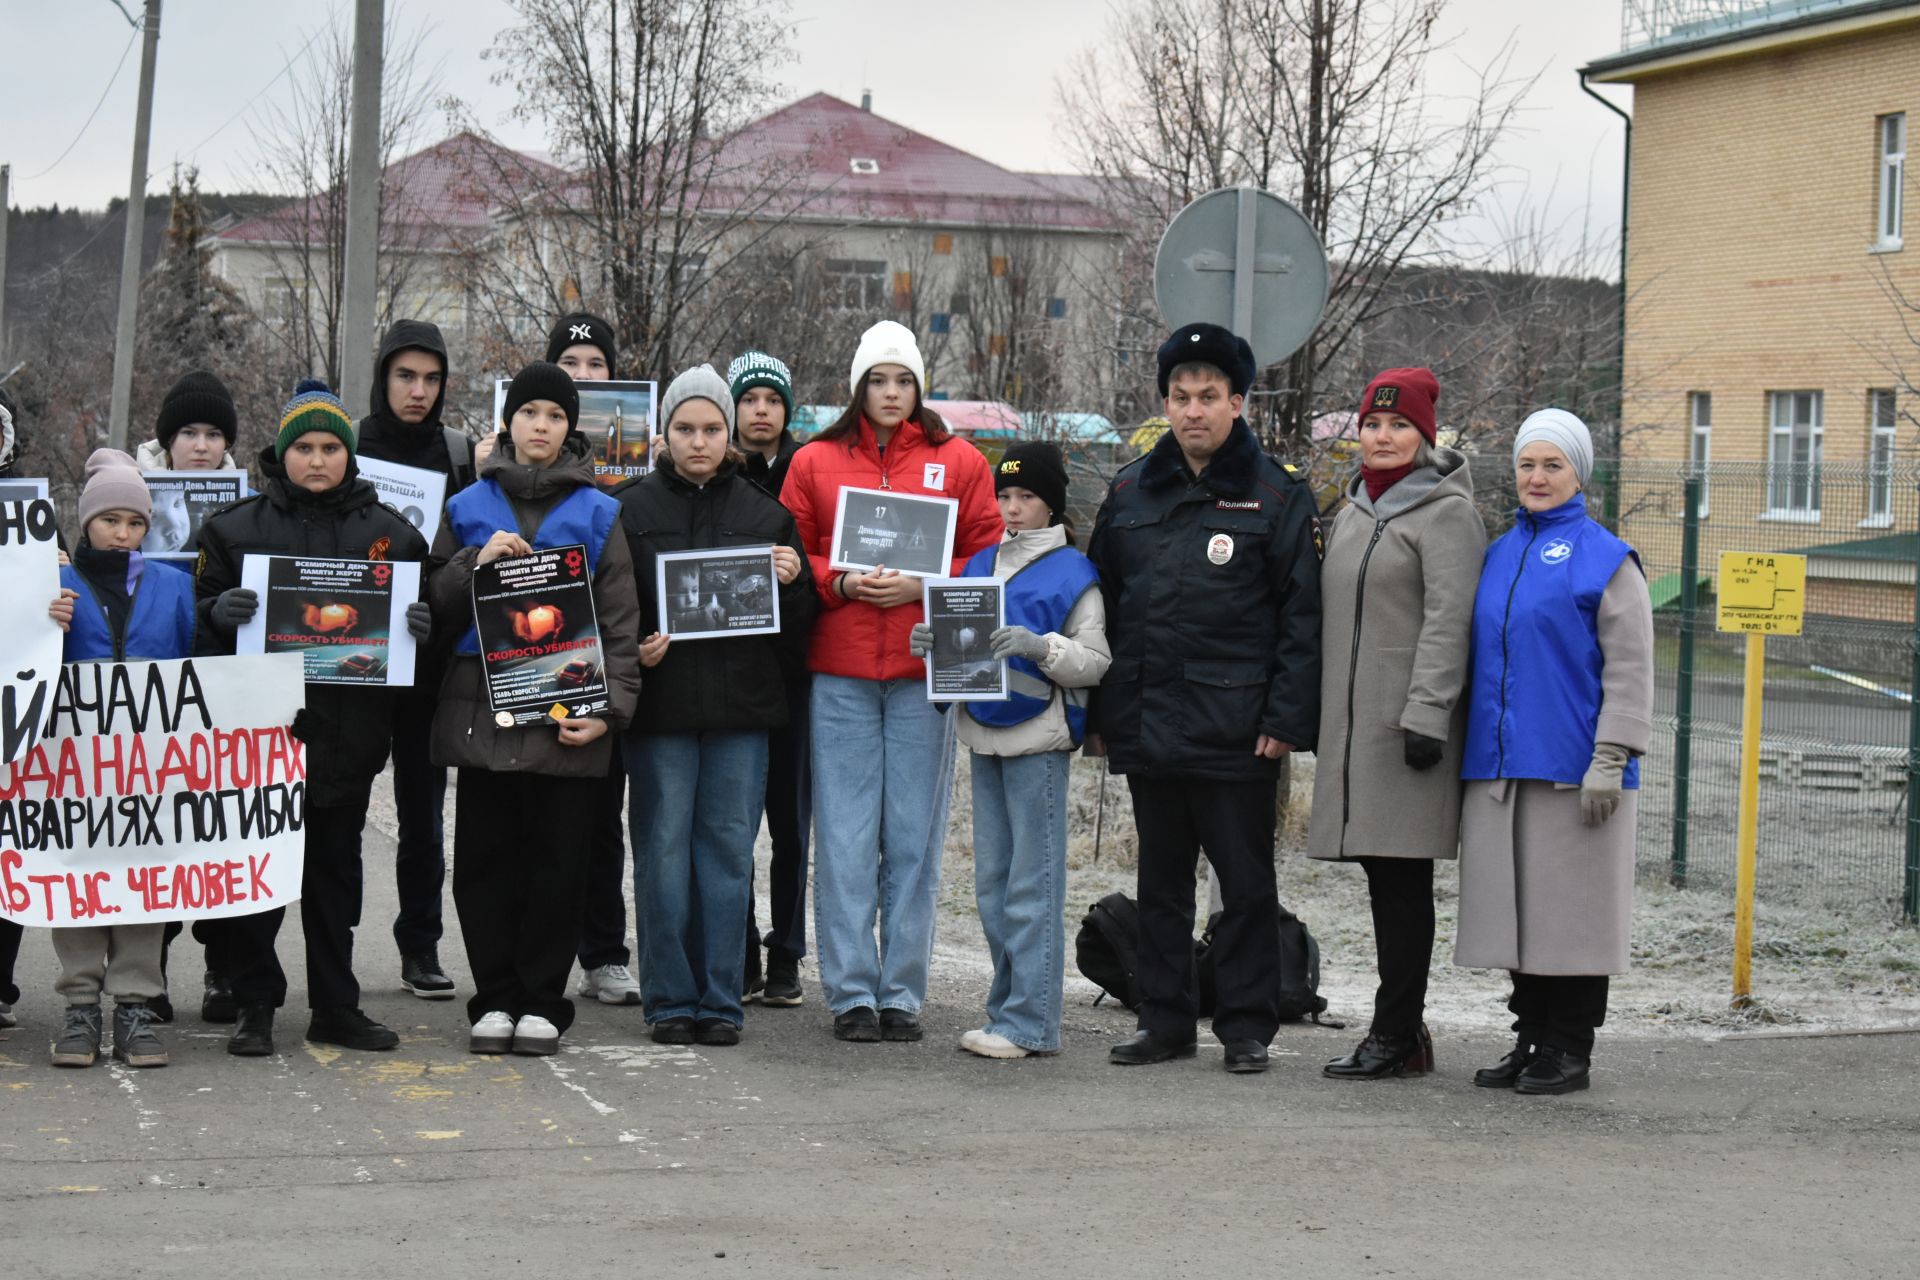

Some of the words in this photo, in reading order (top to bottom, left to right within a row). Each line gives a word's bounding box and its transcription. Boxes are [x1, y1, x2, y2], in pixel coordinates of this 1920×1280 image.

[594, 466, 622, 475] ЕРТВ
[625, 466, 647, 477] ДТП
[146, 481, 184, 491] емирный
[184, 481, 205, 491] День
[206, 481, 236, 490] Памяти
[375, 482, 425, 500] ЕВЫШАЙ
[190, 493, 218, 503] жертв
[219, 492, 236, 503] ДТП
[875, 506, 887, 519] 17
[858, 525, 874, 535] День
[880, 538, 894, 548] ДТП
[295, 560, 345, 569] ВСЕМИРНЫЙ
[347, 563, 369, 571] ДЕНЬ
[494, 556, 539, 569] ВСЕМИРНЫЙ
[541, 554, 561, 564] ДЕНЬ
[500, 567, 530, 577] ПАМЯТИ
[532, 563, 557, 573] ЖЕРТВ
[268, 633, 330, 645] СКОРОСТЬ
[487, 646, 543, 661] СКОРОСТЬ
[42, 659, 213, 739] АЧАЛА
[92, 732, 154, 798] НА
[156, 725, 306, 794] ДОРОГАХ
[0, 795, 164, 852] АВАРИЯХ
[173, 781, 305, 843] ПОГИБЛО
[28, 871, 122, 922] ТЫС.
[127, 852, 273, 912] ЧЕЛОВЕК
